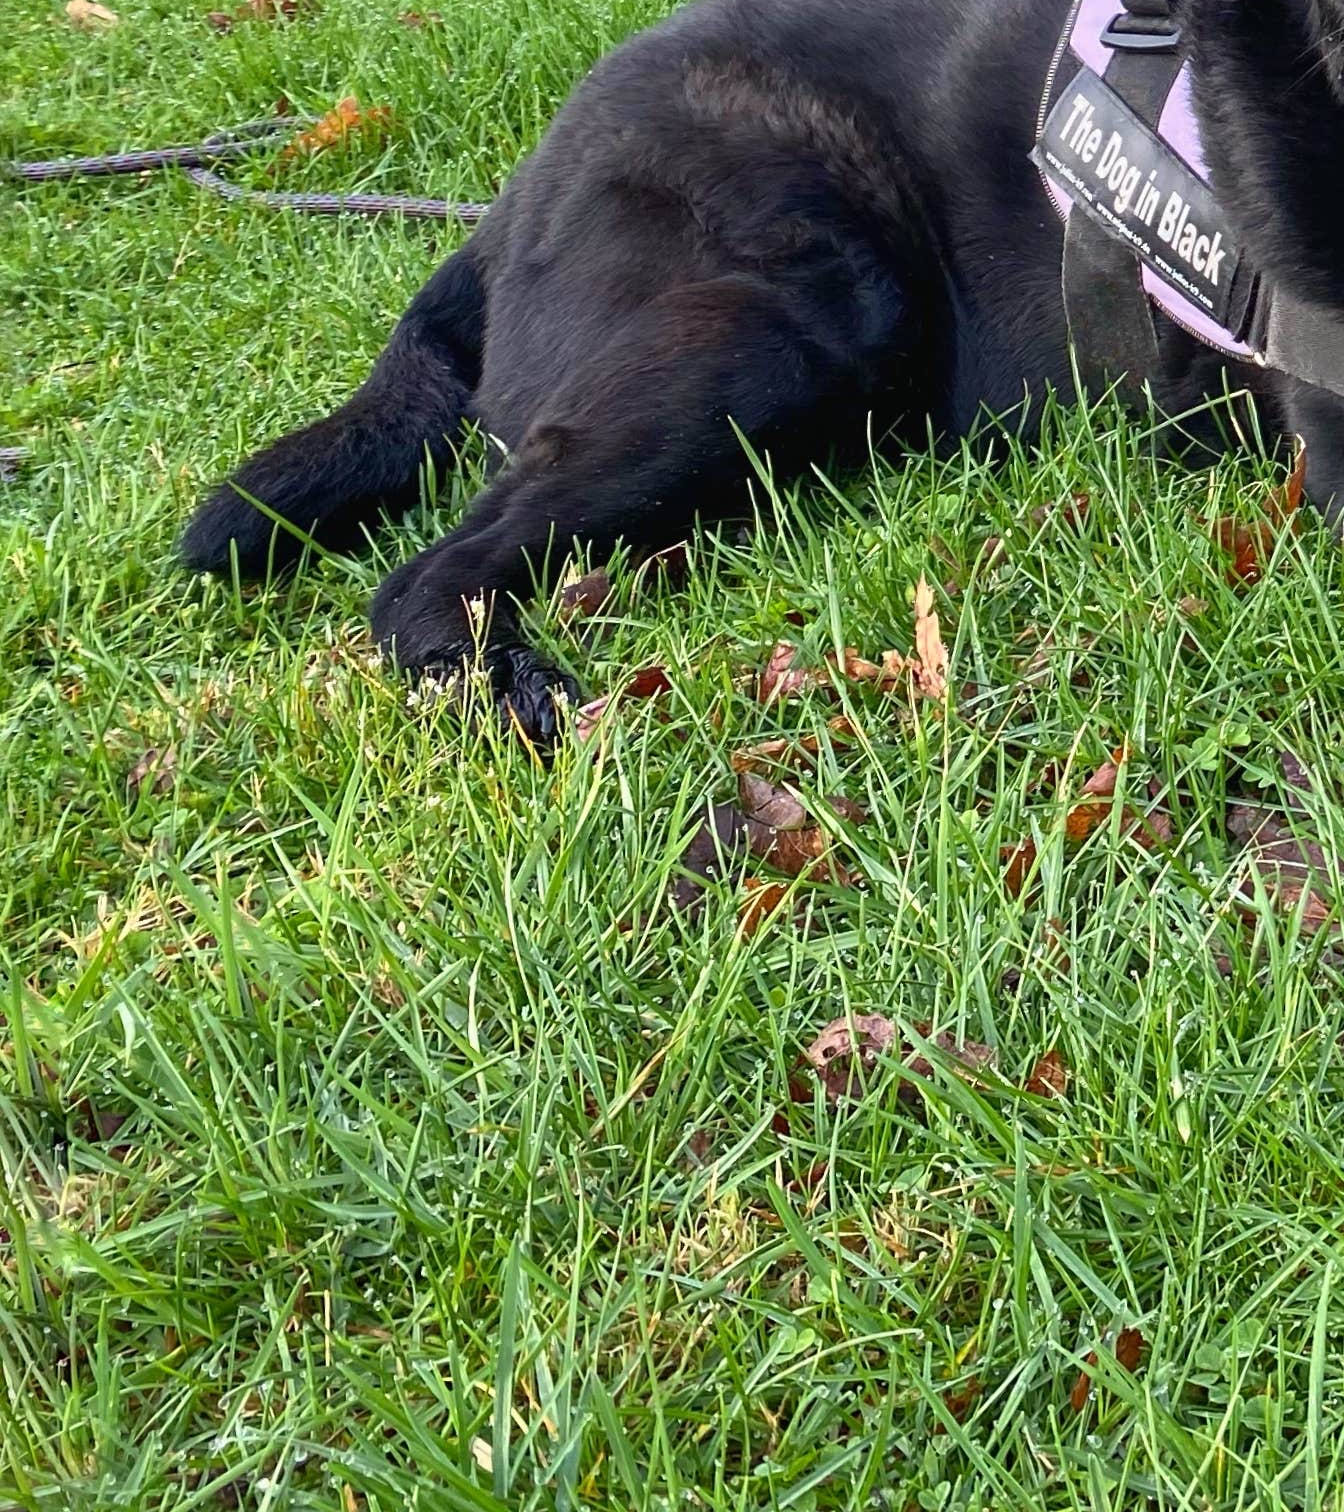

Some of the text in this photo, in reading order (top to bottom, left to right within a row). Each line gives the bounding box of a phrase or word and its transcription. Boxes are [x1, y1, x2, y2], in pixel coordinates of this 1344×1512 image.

[1059, 92, 1103, 163] The
[1095, 130, 1142, 214] Dog
[1133, 169, 1160, 227] in
[1156, 190, 1226, 286] Black
